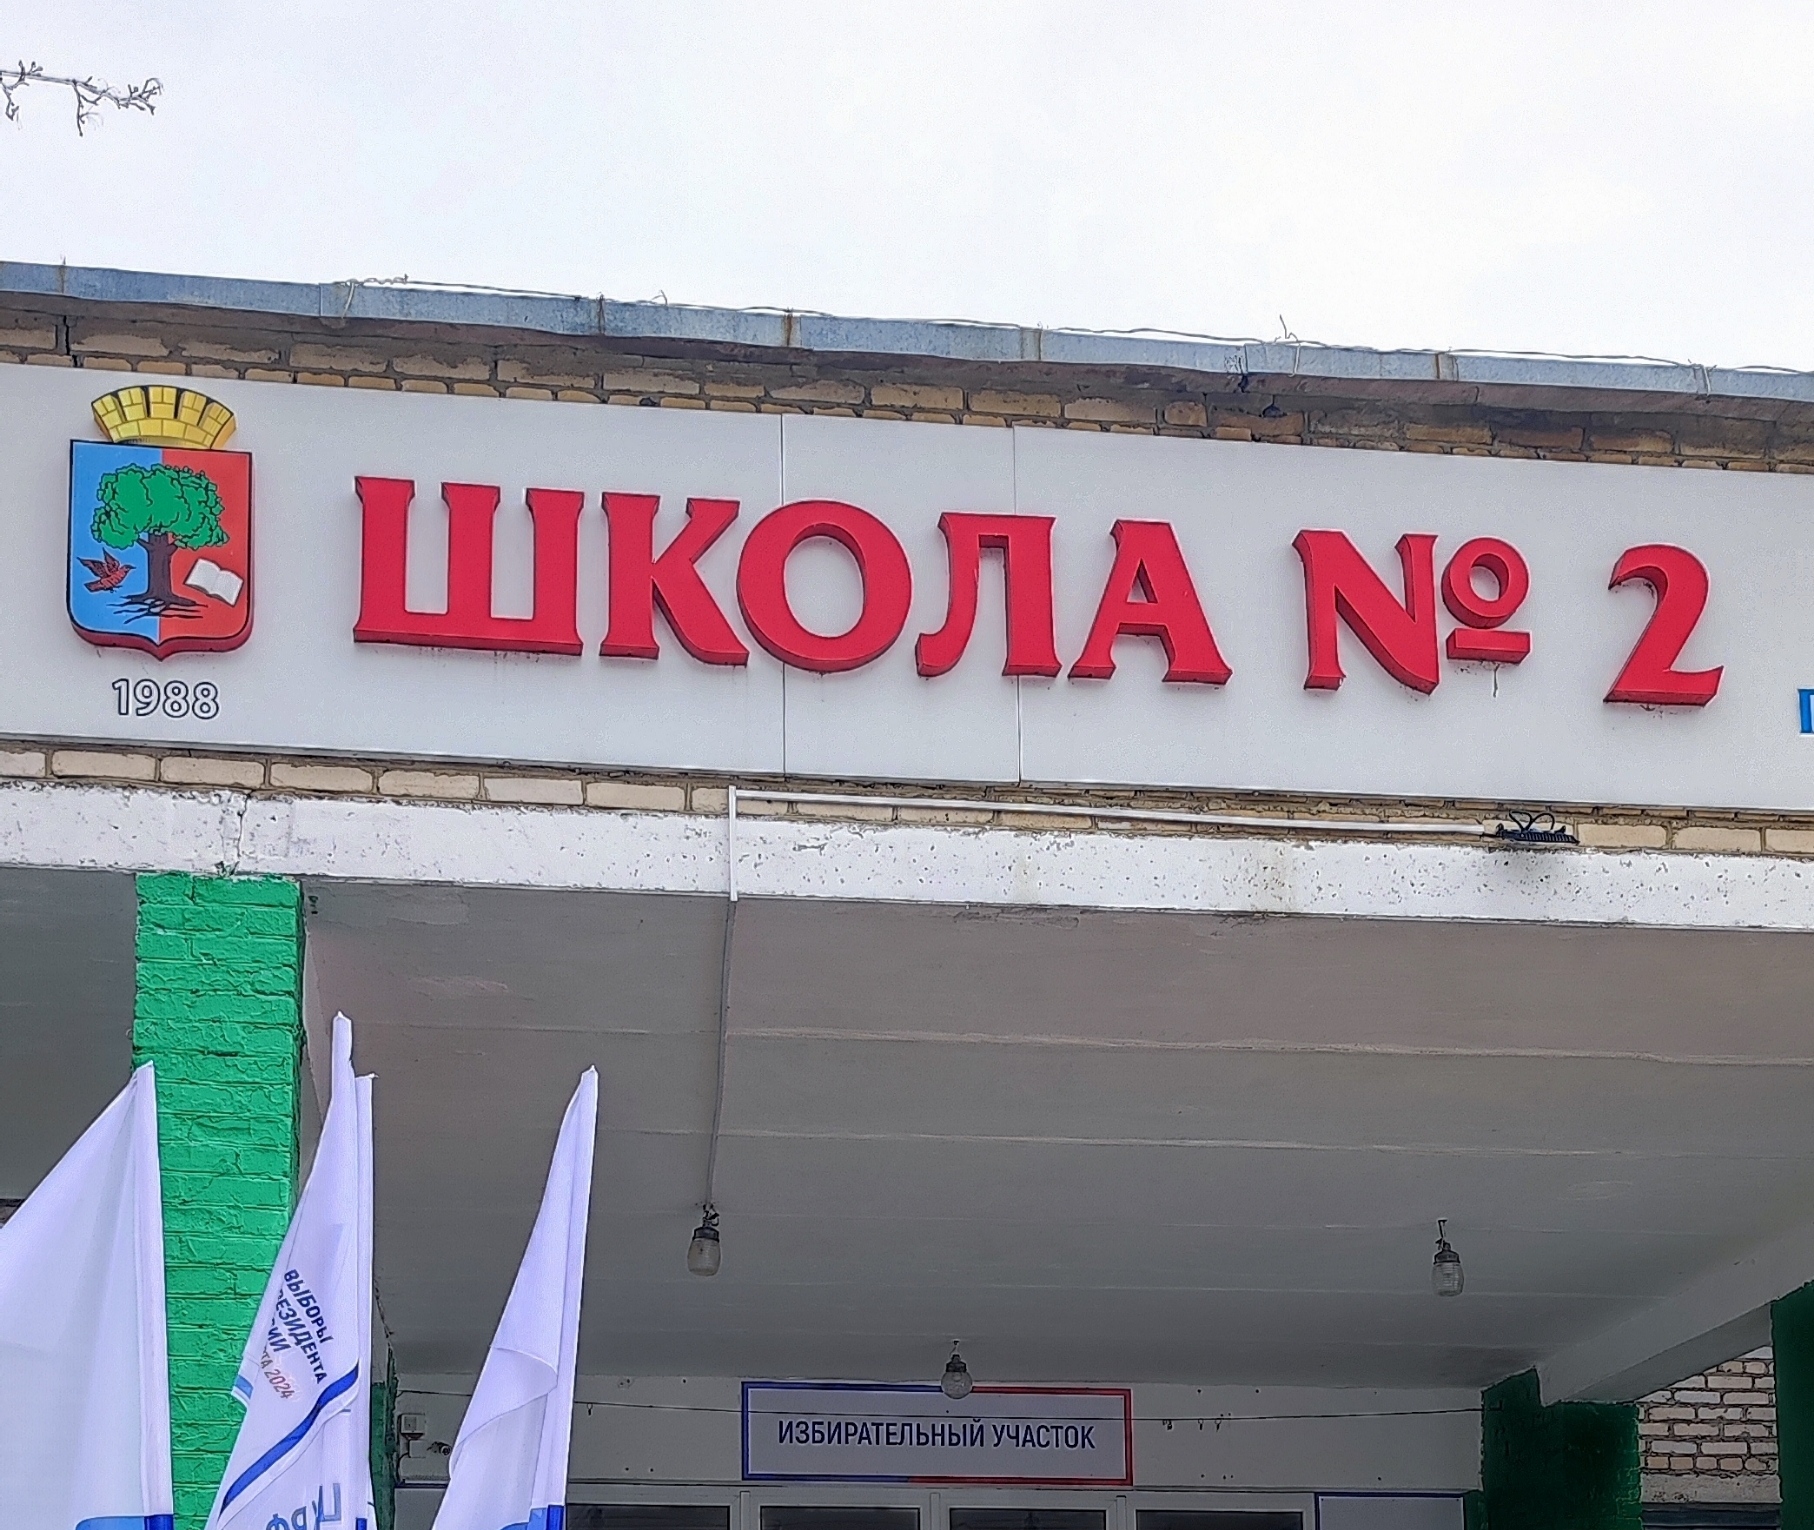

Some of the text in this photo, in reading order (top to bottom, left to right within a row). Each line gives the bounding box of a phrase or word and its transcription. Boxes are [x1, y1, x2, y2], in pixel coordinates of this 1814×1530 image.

[353, 475, 1725, 708] ШКОЛА № 2
[112, 678, 220, 720] 1988
[284, 1268, 334, 1344] ВЫБОРЫ
[264, 1368, 295, 1400] 2024
[777, 1418, 1096, 1450] ИЗБИРАТЕЛЬНЫЙ УЧАСТОК
